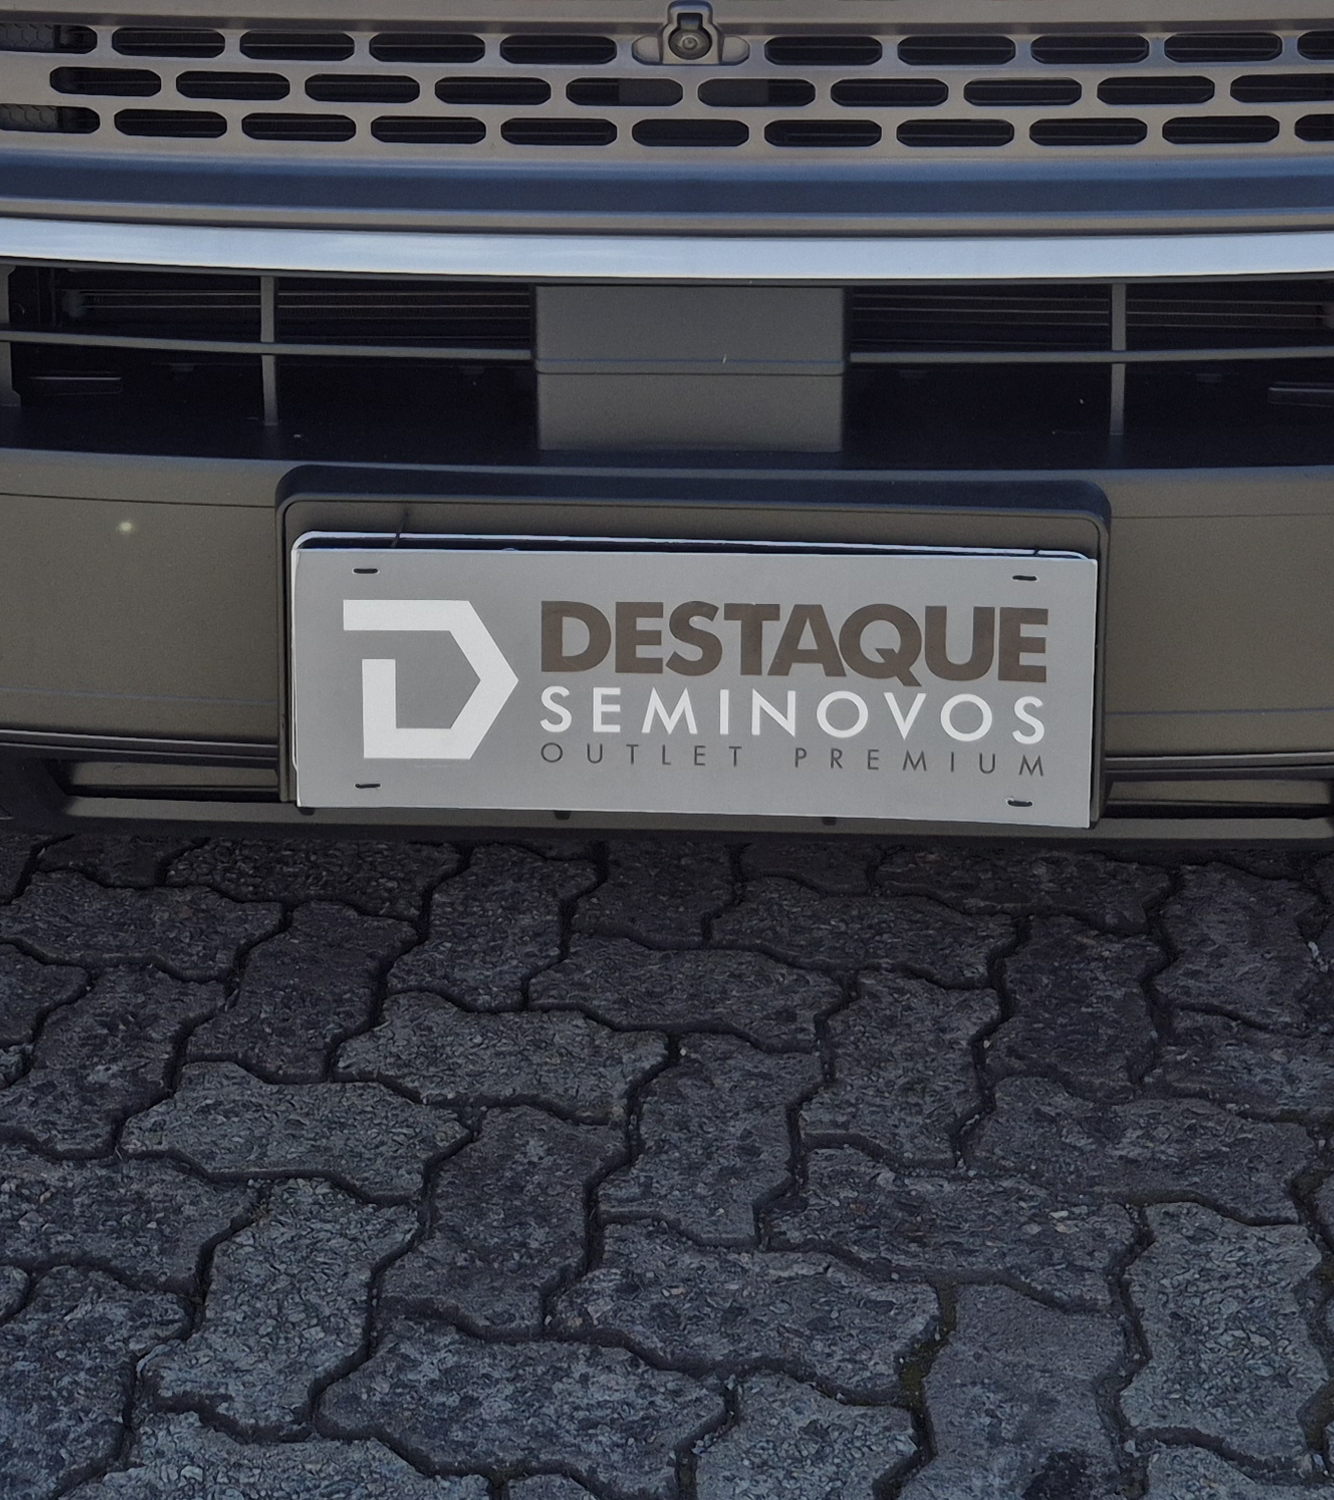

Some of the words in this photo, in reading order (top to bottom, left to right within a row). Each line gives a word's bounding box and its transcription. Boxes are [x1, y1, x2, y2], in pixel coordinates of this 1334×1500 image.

[540, 599, 1049, 686] DESTAQUE
[540, 686, 1046, 745] SEMINOVOS
[540, 742, 745, 768] OUTLET
[795, 748, 1046, 778] PREMIUM
